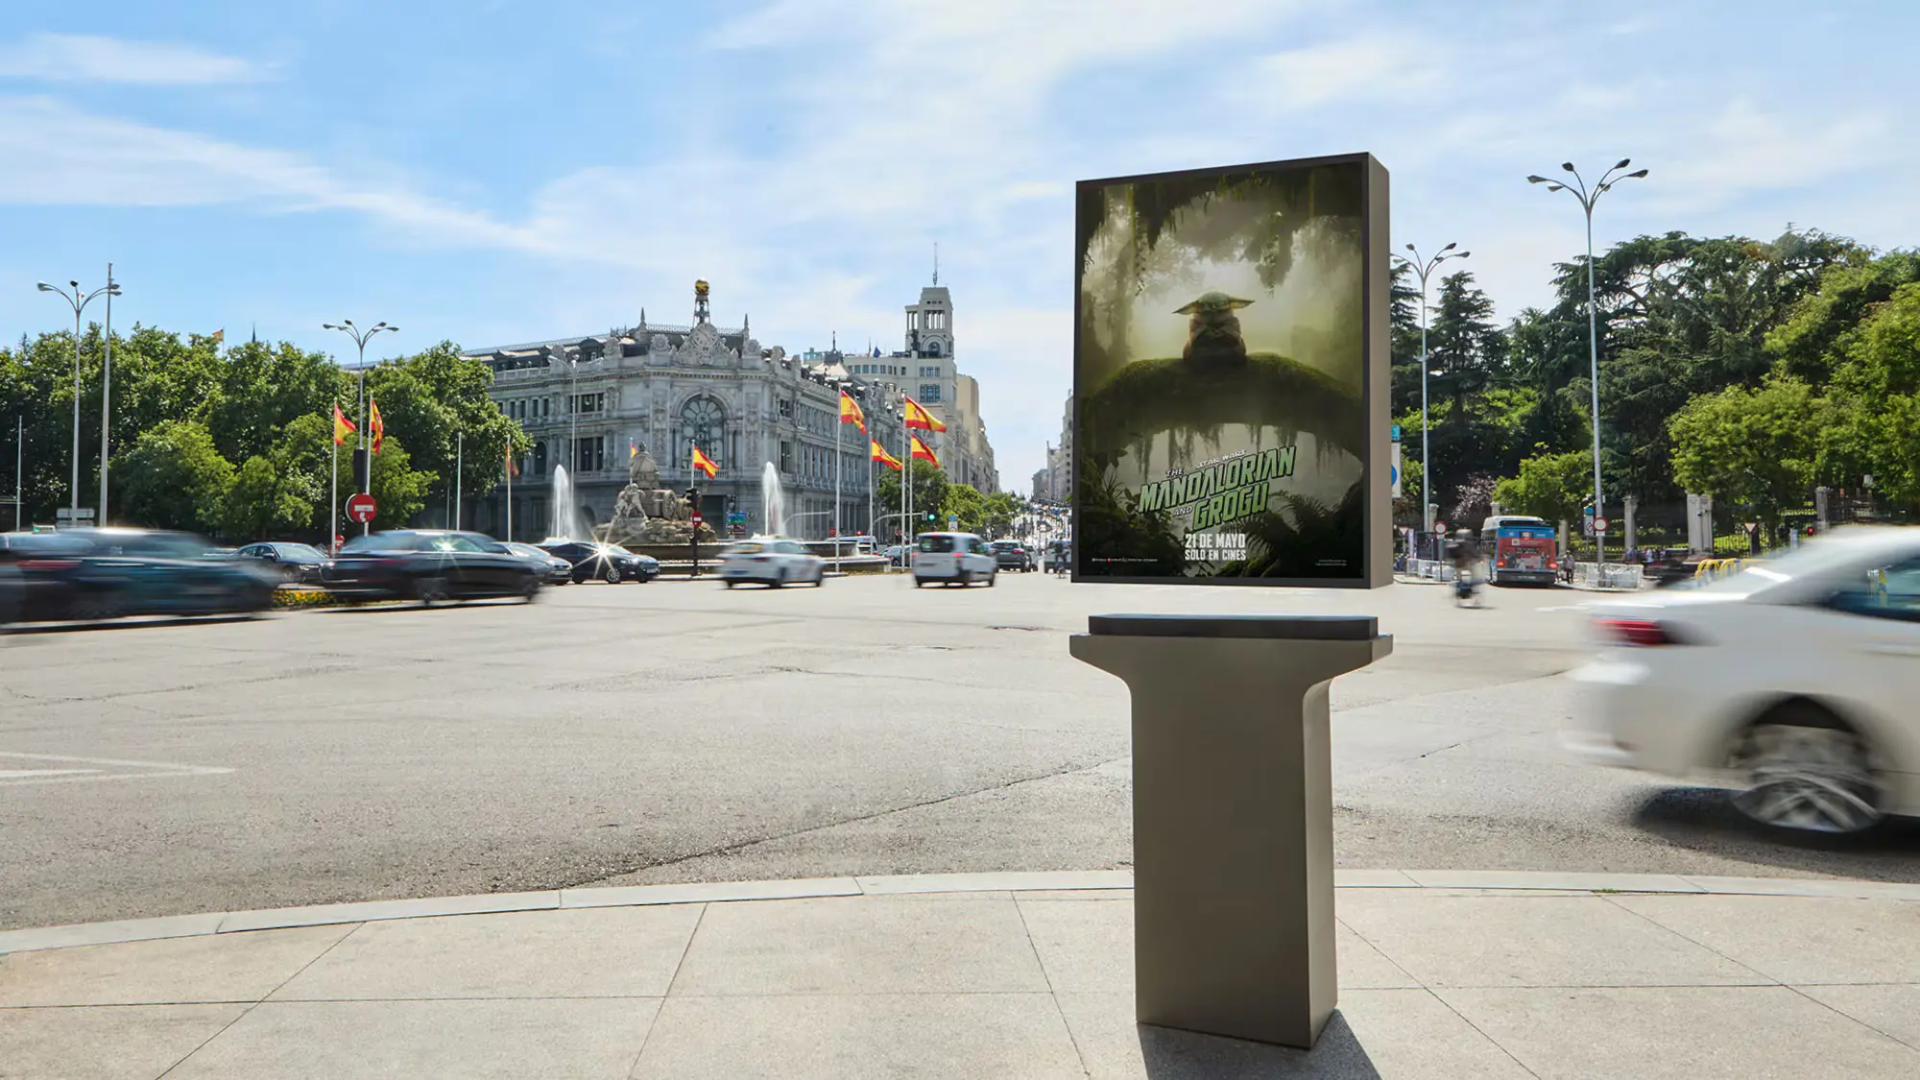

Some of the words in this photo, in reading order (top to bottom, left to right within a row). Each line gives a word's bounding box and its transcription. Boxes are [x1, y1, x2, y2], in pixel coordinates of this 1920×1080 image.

[1139, 446, 1297, 513] MANDALORIAN
[1166, 469, 1183, 478] THE
[1173, 505, 1194, 517] AND
[1192, 482, 1270, 531] GROGU
[1185, 533, 1196, 548] 21
[1200, 533, 1213, 548] DE
[1216, 533, 1246, 548] MAYO
[1185, 549, 1206, 560] SOLO
[1209, 549, 1219, 560] EN
[1222, 549, 1246, 560] CINES
